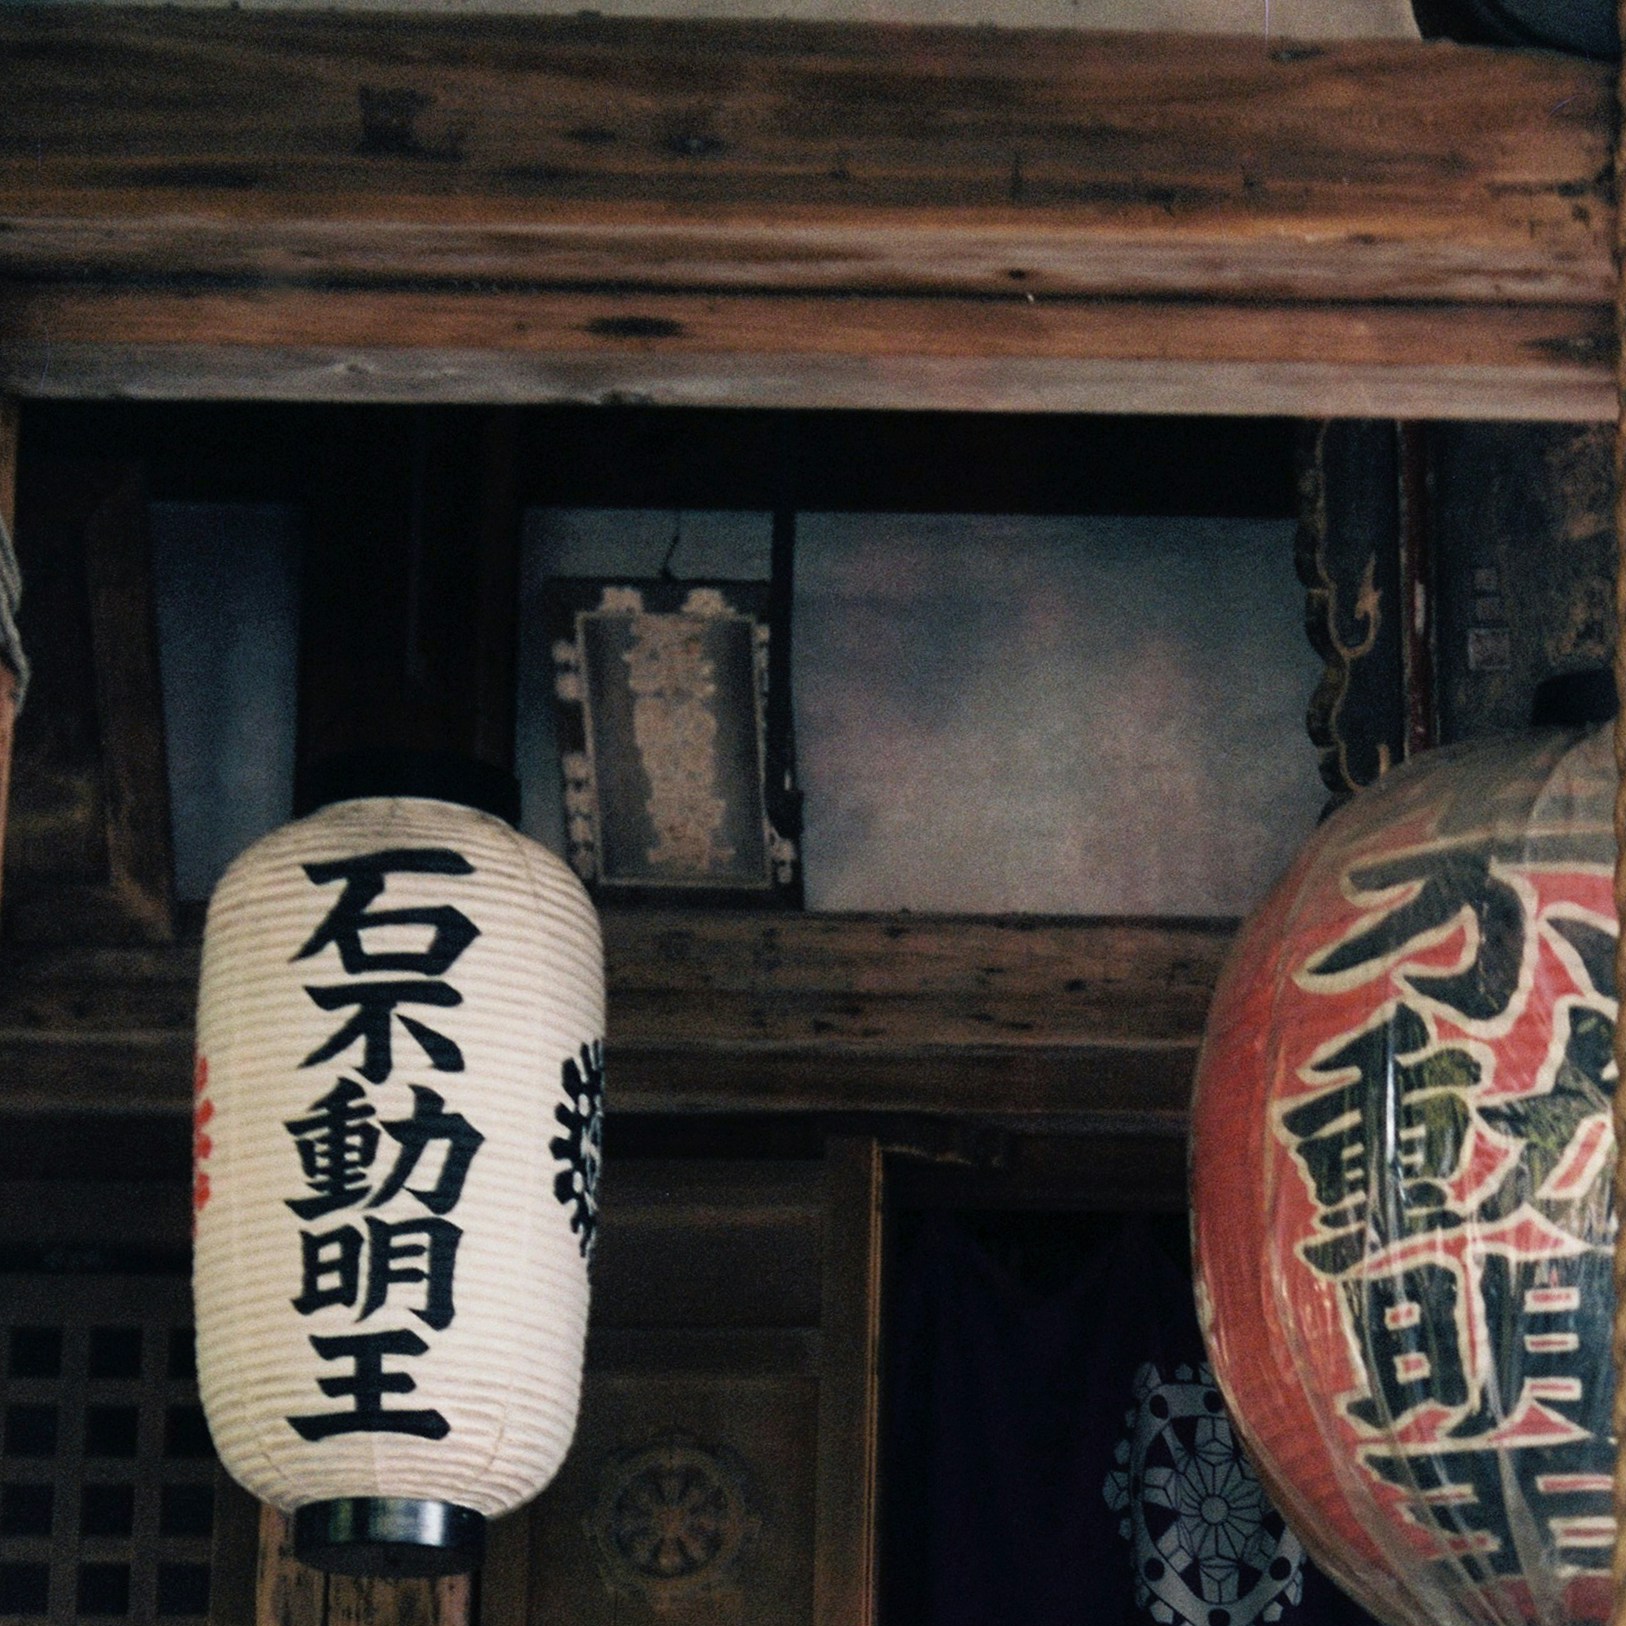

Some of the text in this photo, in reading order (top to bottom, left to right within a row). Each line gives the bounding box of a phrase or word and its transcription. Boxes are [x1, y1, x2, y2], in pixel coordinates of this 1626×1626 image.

[287, 848, 486, 1440] 石不動明王
